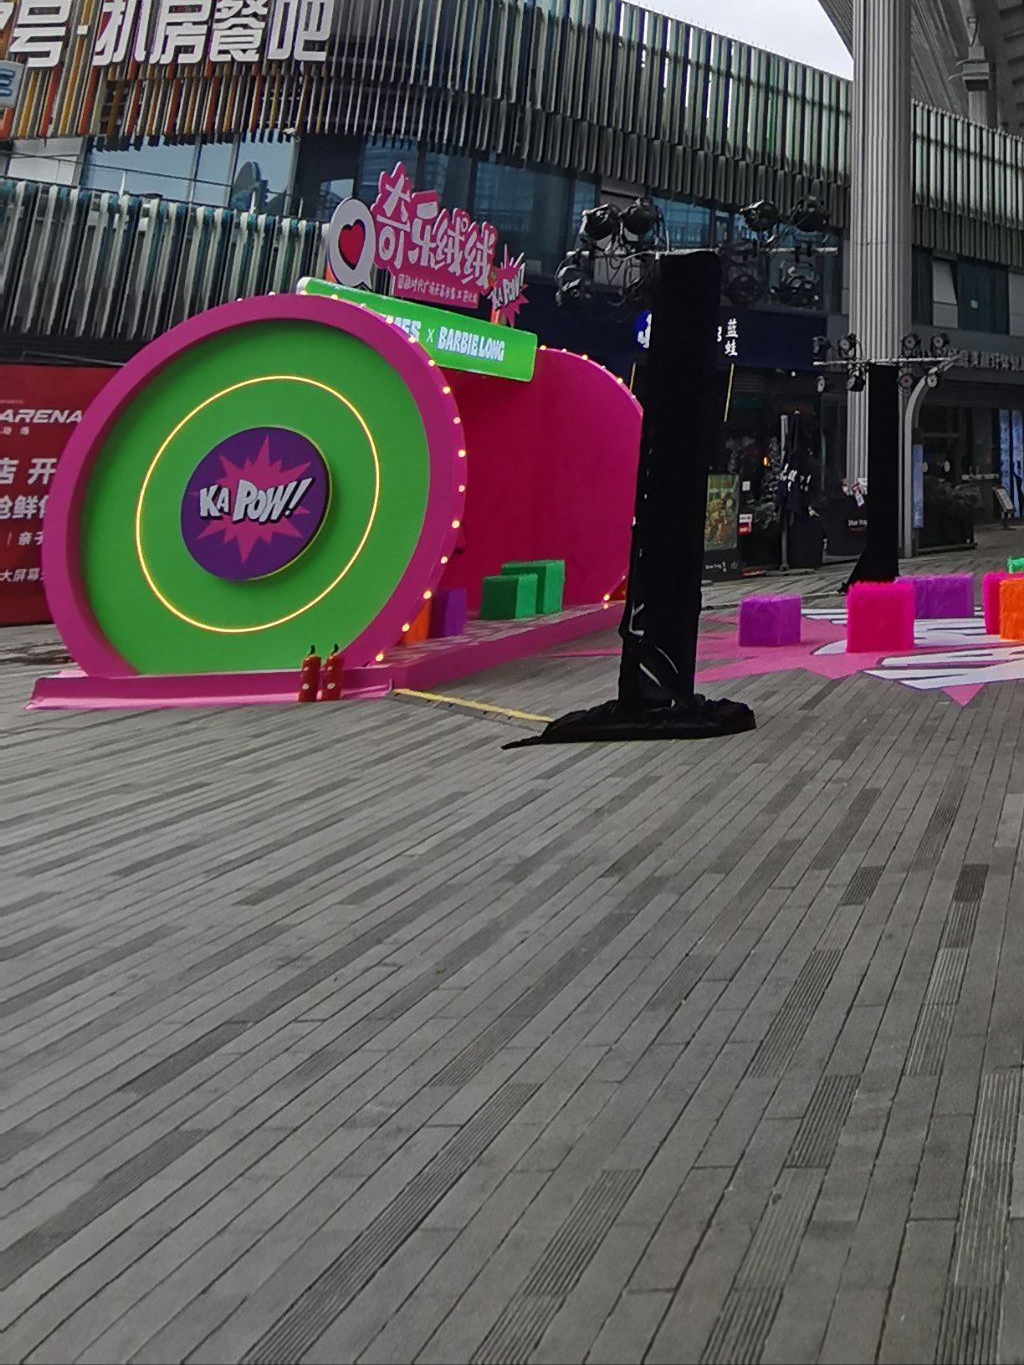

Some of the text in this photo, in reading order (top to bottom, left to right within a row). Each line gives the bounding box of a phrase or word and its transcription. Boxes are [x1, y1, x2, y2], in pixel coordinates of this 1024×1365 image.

[437, 326, 479, 356] BARBIE
[478, 335, 506, 361] LONG
[724, 318, 739, 356] 蓝蛙
[199, 477, 313, 522] KA POW!
